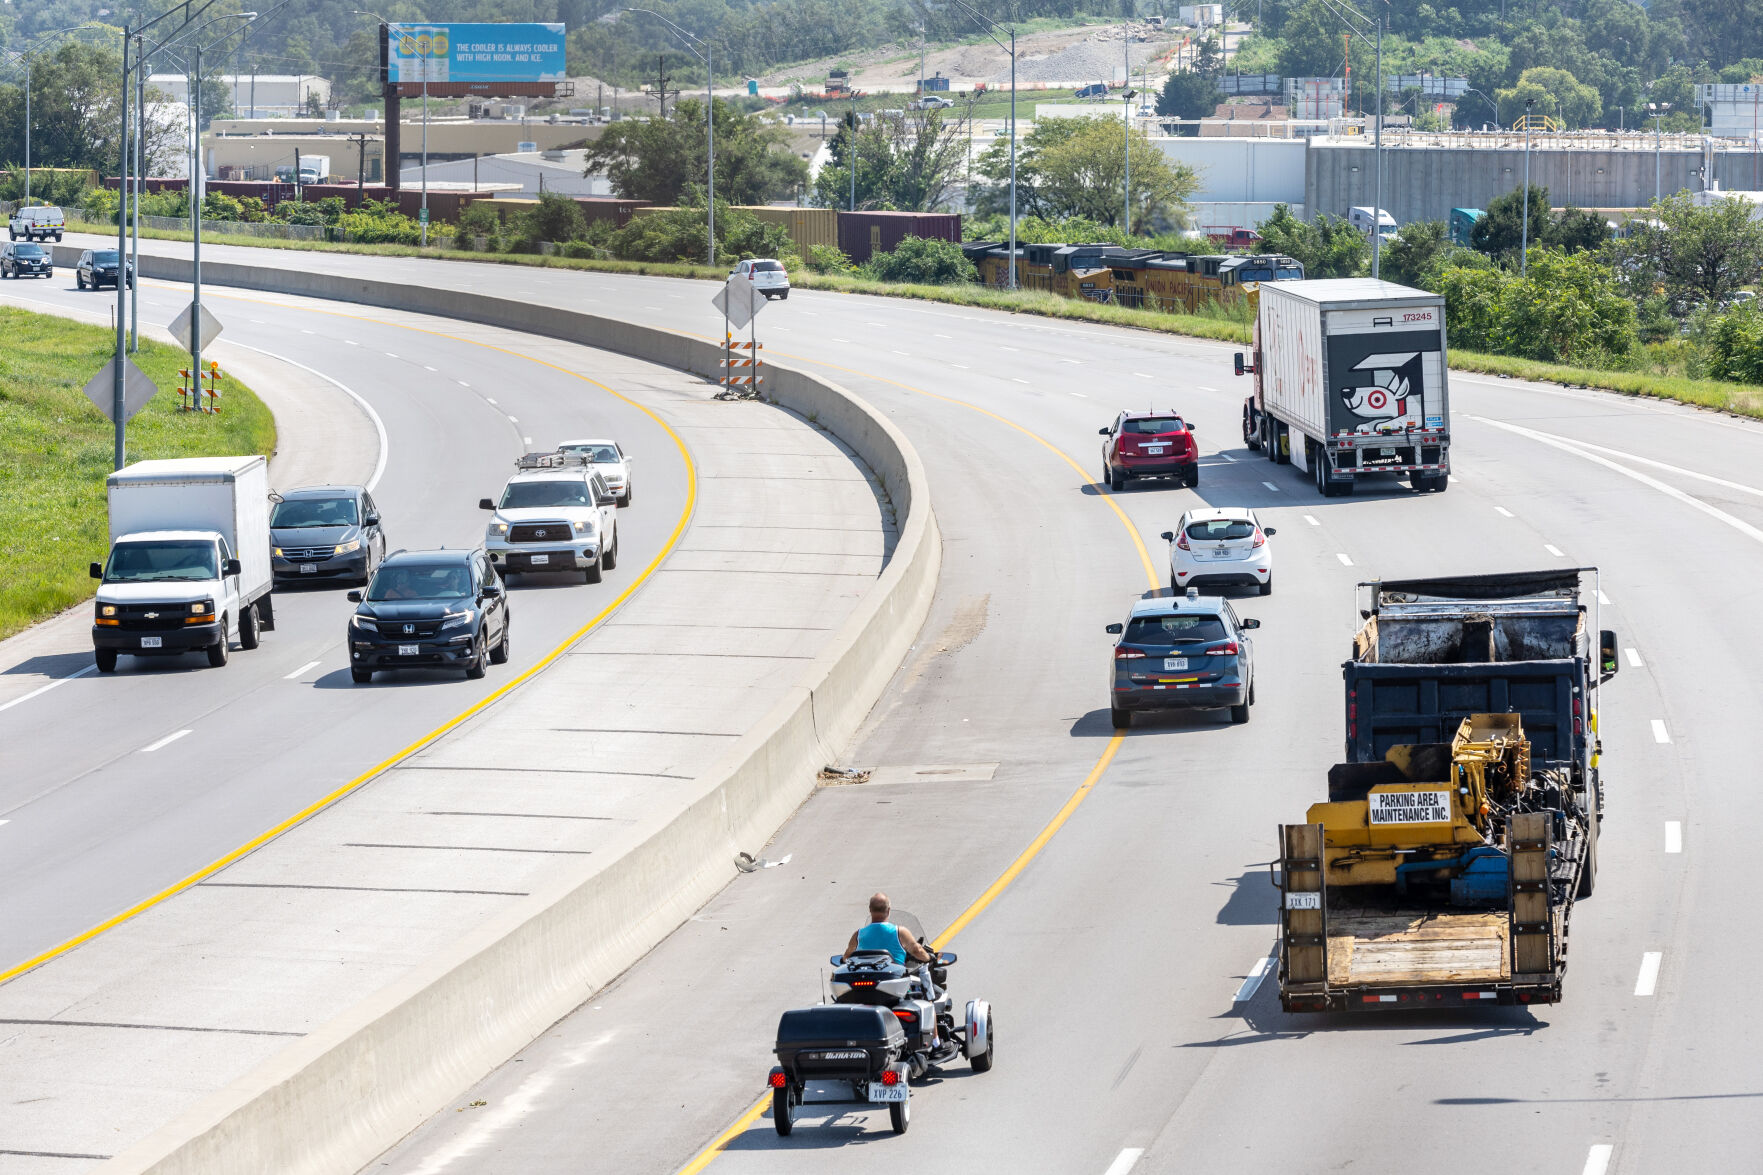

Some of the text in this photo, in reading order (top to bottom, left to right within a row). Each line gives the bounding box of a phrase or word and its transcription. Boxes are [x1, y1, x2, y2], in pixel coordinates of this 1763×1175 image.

[456, 44, 558, 52] THE COOLER IS ALWAYS COOLER
[456, 54, 543, 62] WITH HIGH NOON. AND ICE.
[1145, 279, 1166, 293] UNION
[1403, 312, 1432, 322] 173245
[1380, 793, 1439, 808] PARKING AREA
[1372, 807, 1448, 822] MAINTENANCE INC.
[874, 1090, 902, 1099] XVP 226
